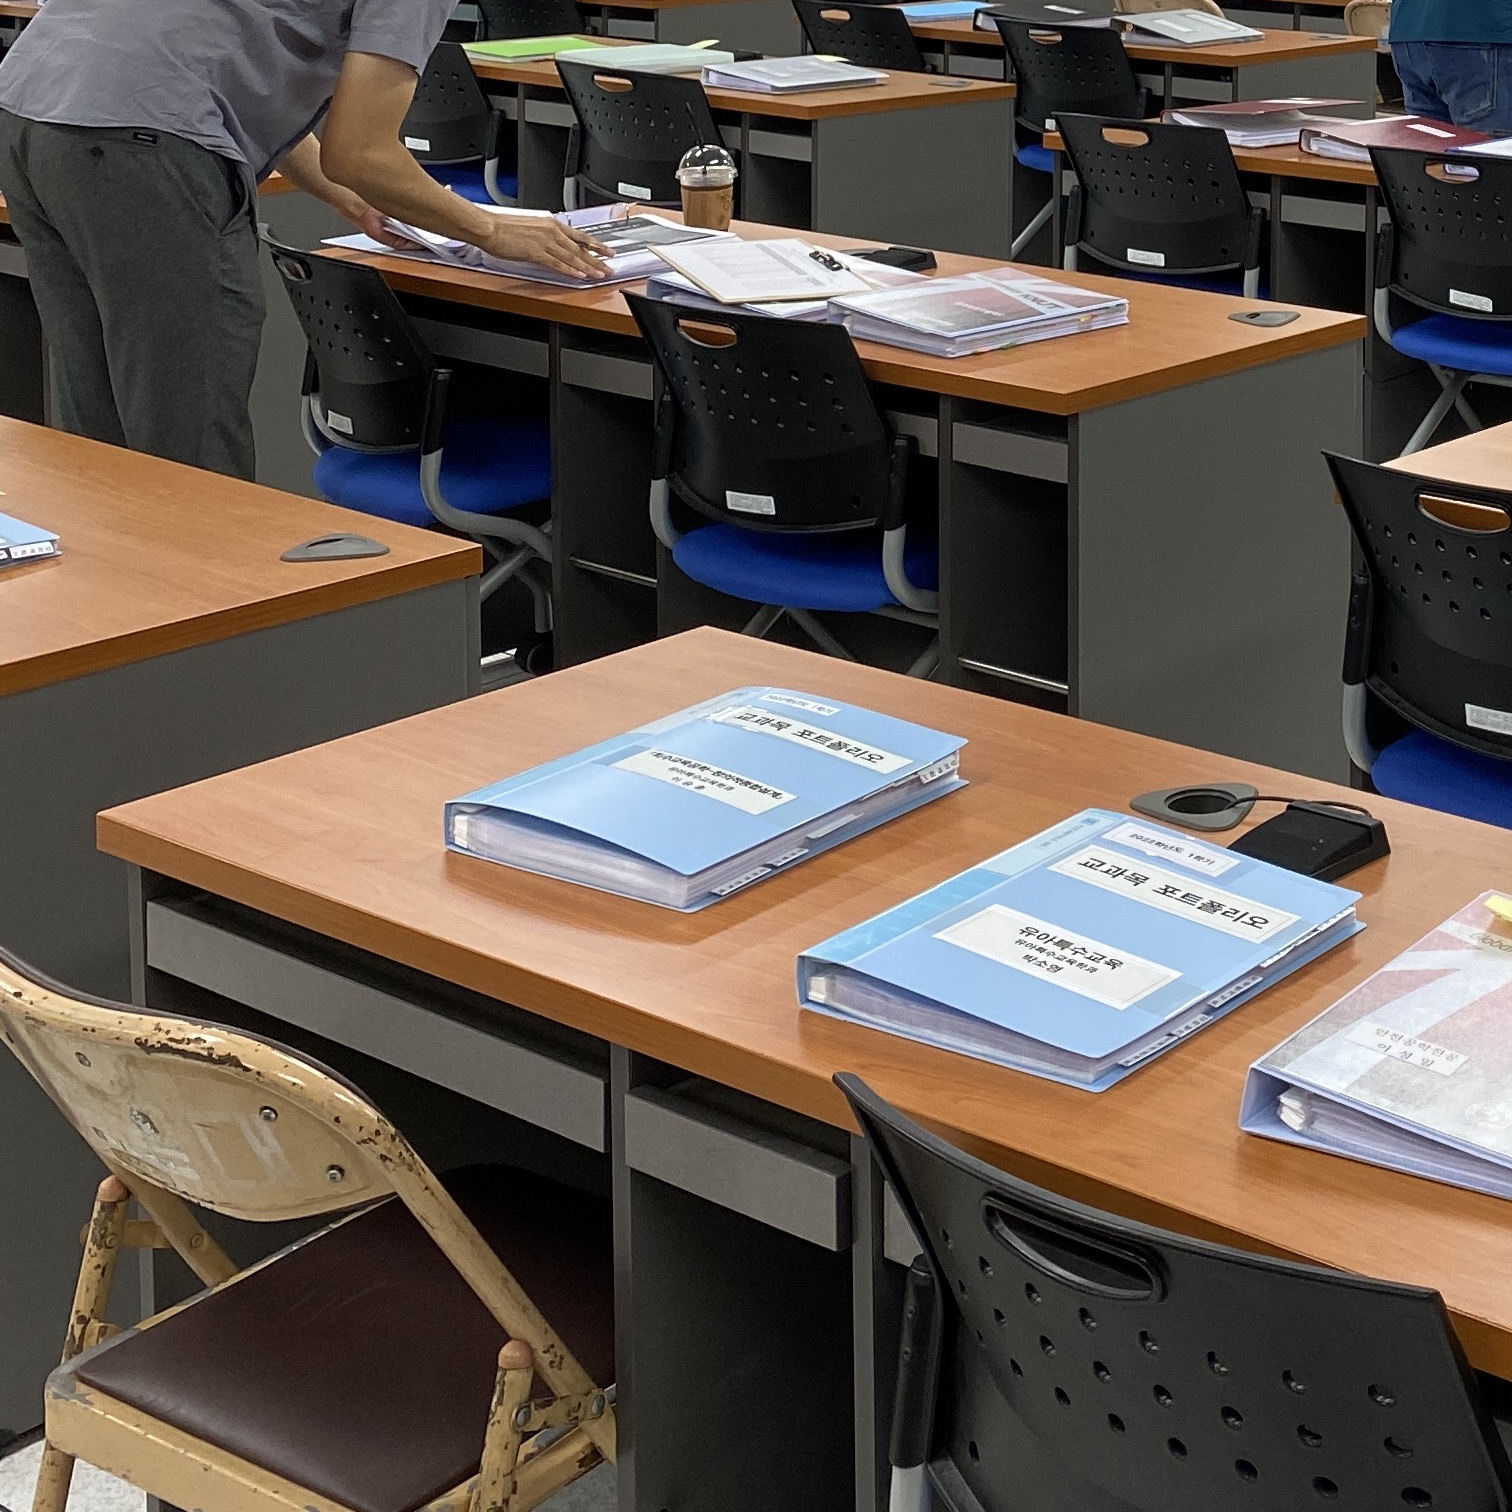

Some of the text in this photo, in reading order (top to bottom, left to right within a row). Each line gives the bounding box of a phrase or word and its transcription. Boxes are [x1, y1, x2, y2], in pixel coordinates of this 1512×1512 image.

[733, 712, 885, 764] 교과목 포트폴리오
[1128, 832, 1216, 867] 2022학년도 1학기
[1076, 857, 1270, 930] 교과목 포트폴리오
[1015, 939, 1099, 973] 유아특수교육학과
[1019, 926, 1124, 970] 유아특수교육
[1376, 1028, 1460, 1061] 안전공학전공
